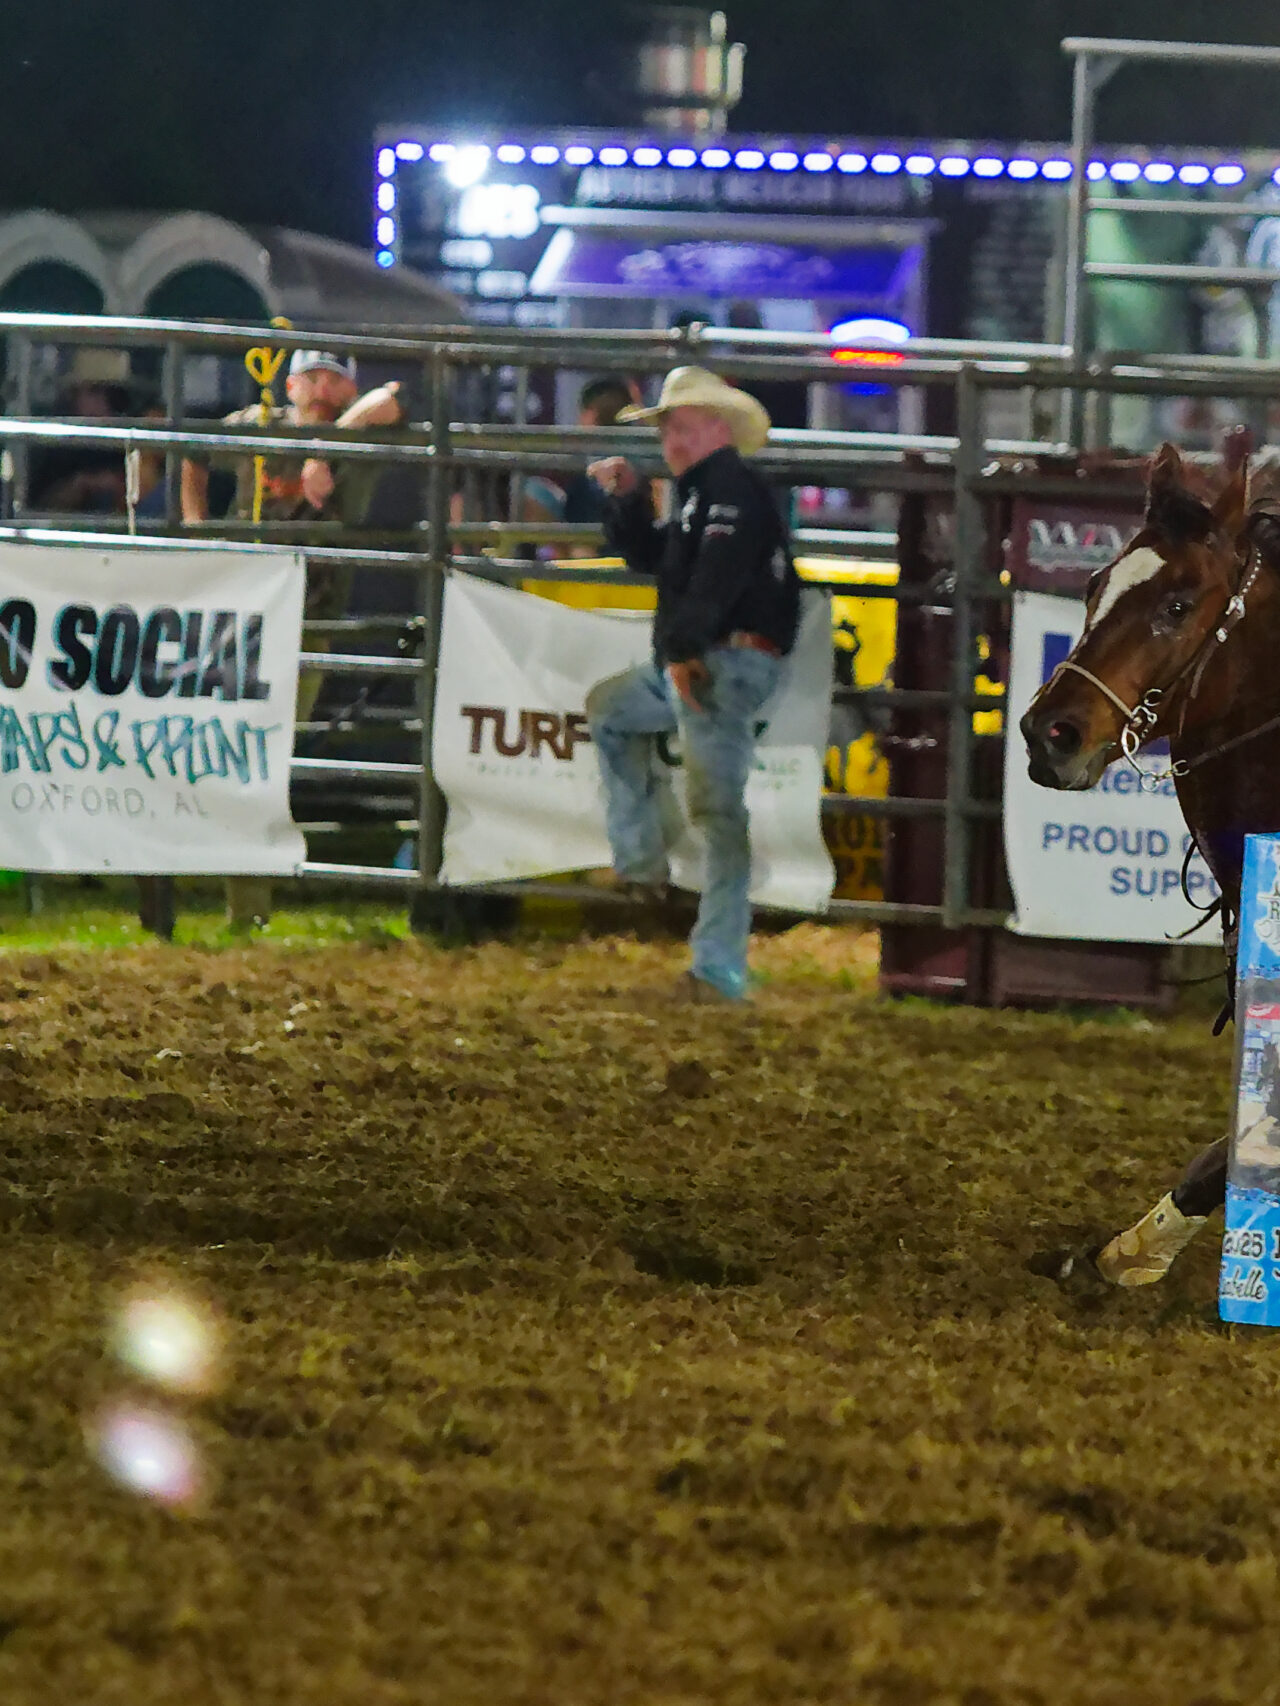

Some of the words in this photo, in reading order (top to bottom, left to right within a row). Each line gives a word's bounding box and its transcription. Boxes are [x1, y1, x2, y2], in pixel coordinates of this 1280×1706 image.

[48, 603, 271, 701] SOCIAL
[93, 709, 126, 773] &
[130, 713, 281, 784] PRINT
[460, 705, 592, 762] TURF
[174, 790, 208, 819] AL
[1042, 821, 1169, 858] PROUD
